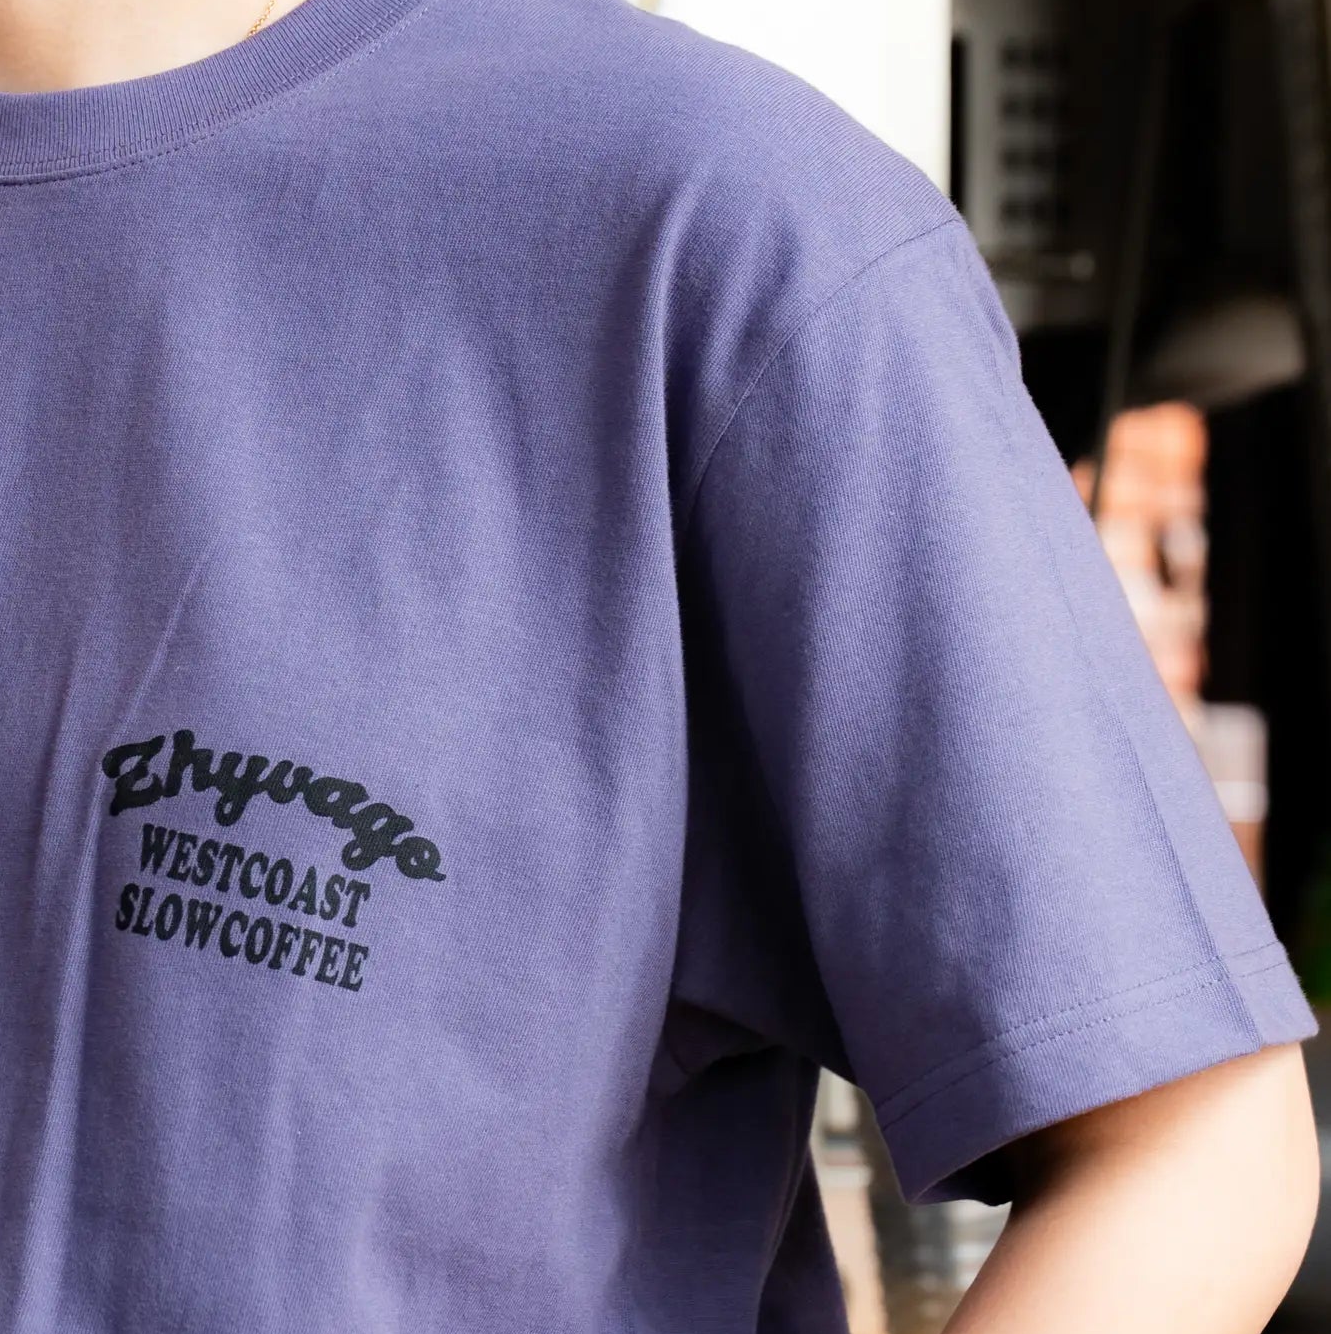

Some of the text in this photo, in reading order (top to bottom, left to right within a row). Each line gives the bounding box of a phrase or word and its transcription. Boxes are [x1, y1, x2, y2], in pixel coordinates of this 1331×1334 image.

[102, 729, 447, 882] Zhyvago
[140, 823, 370, 928] WESTCOAST
[115, 882, 369, 992] SLOWCOFFEE
